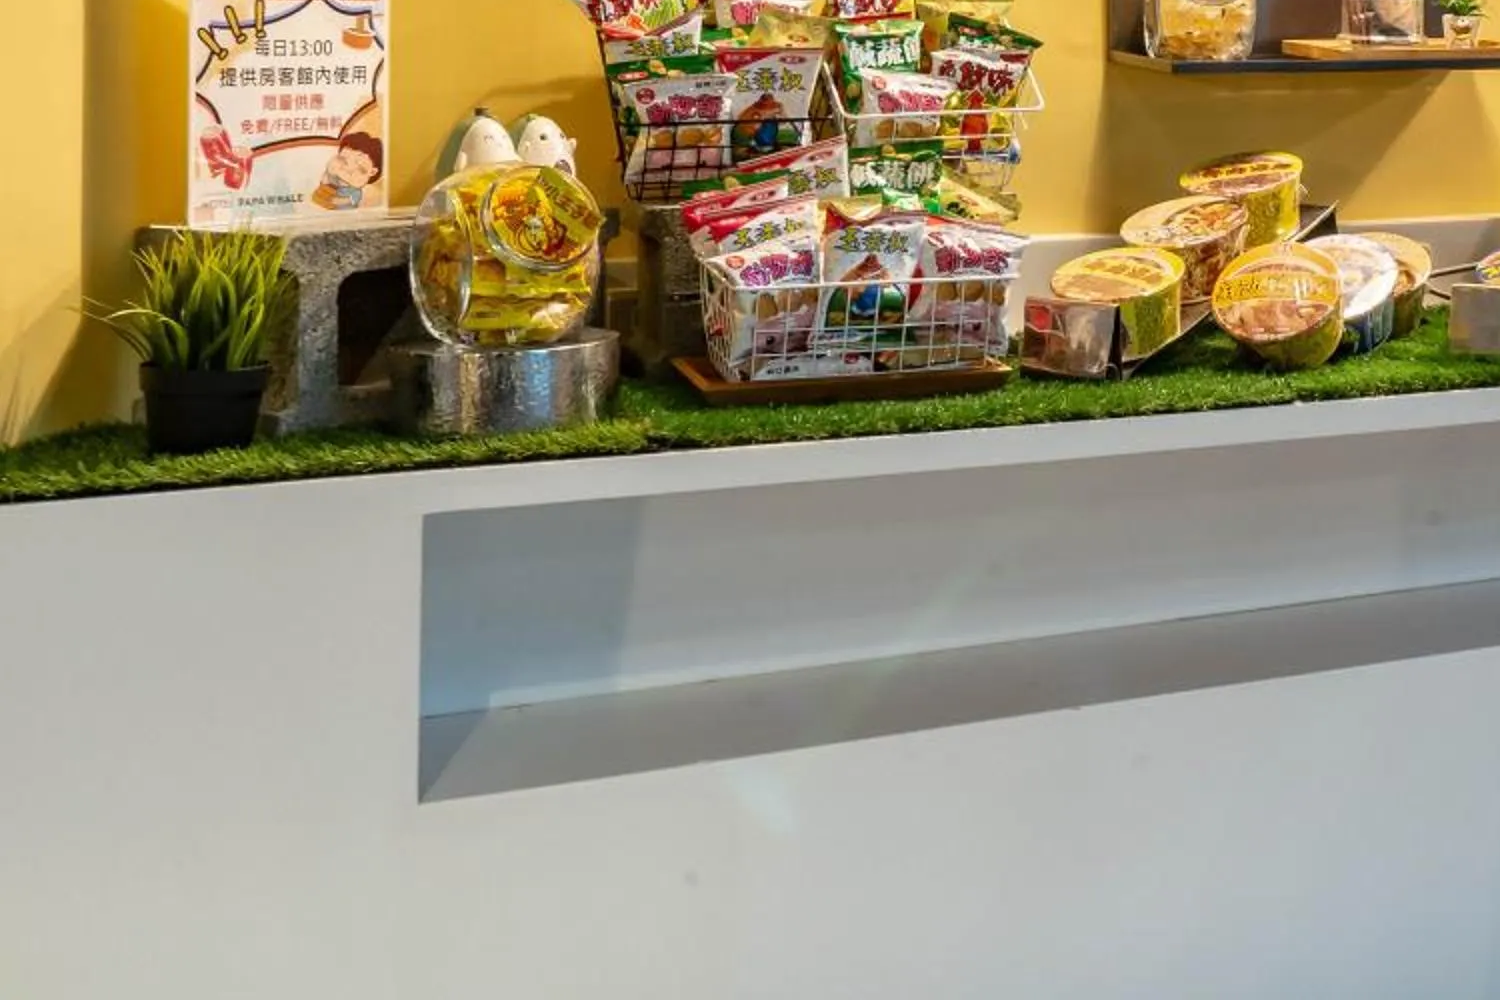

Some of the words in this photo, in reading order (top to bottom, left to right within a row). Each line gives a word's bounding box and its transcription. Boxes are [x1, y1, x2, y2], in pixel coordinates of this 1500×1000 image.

[254, 39, 333, 57] 每日13:00
[219, 65, 368, 88] 提供房客館內使用
